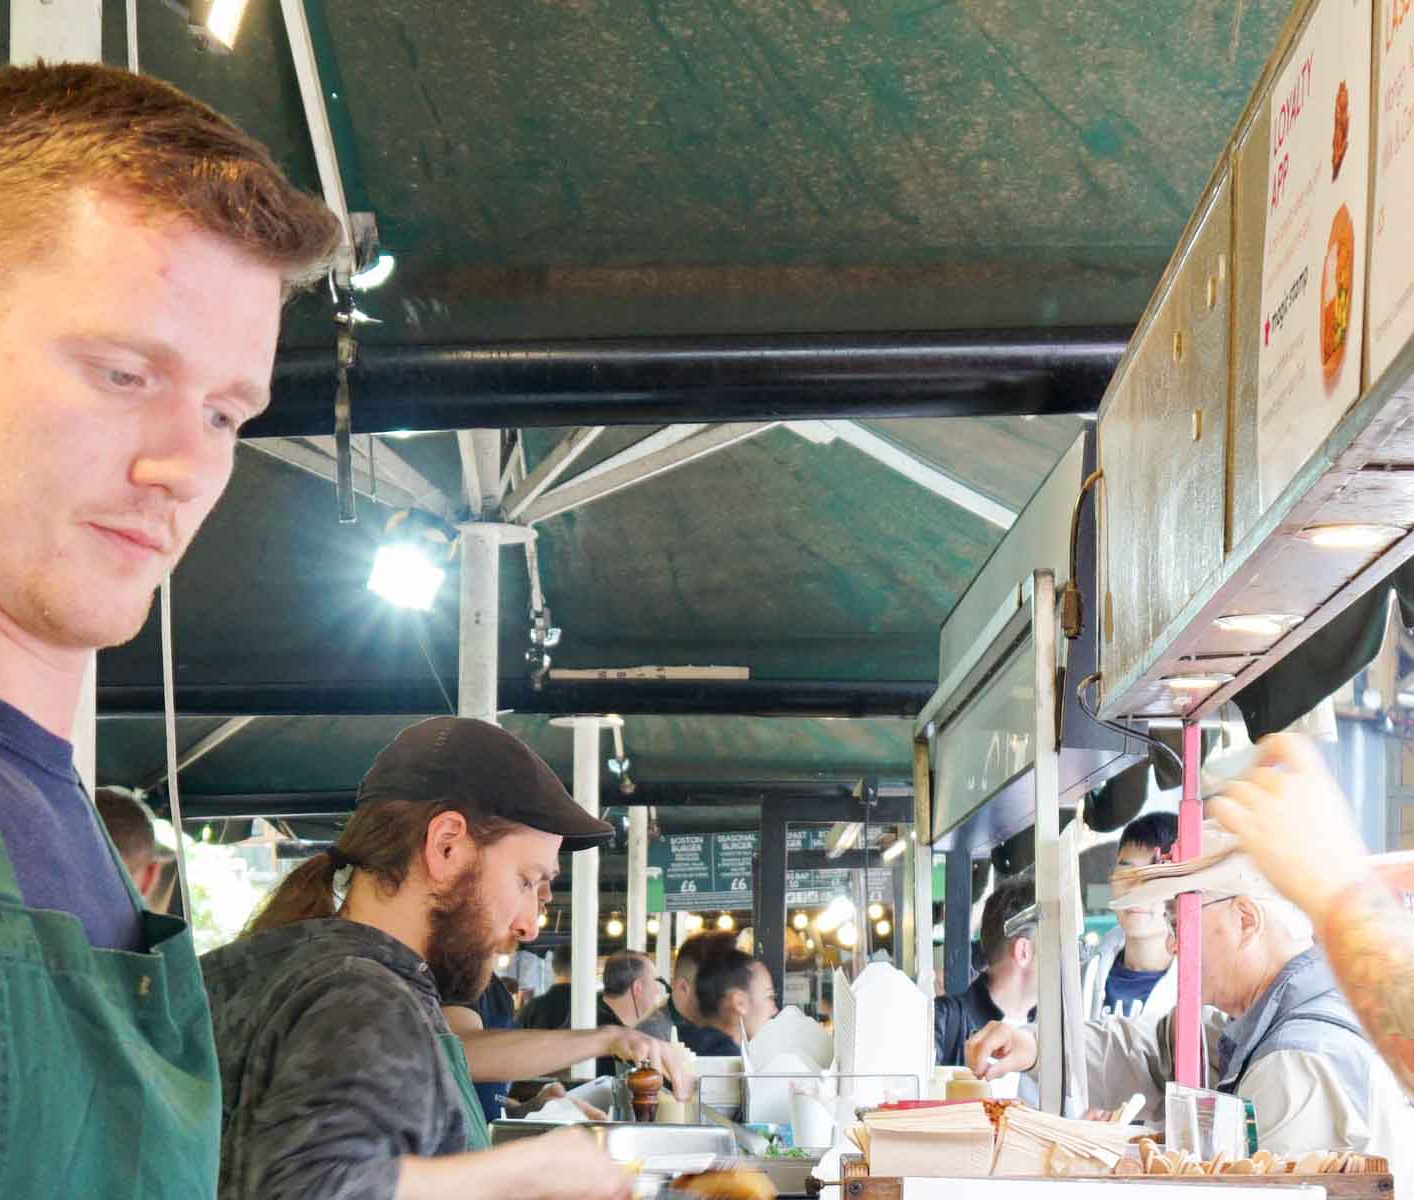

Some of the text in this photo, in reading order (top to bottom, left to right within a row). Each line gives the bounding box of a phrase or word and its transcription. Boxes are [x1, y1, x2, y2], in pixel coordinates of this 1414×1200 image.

[1274, 51, 1314, 158] LOYALTY
[1271, 152, 1289, 214] APP
[670, 836, 704, 845] BOSTON
[722, 841, 752, 850] BURGER
[671, 844, 702, 853] BURGER
[681, 880, 697, 892] £6
[731, 878, 747, 891] £6
